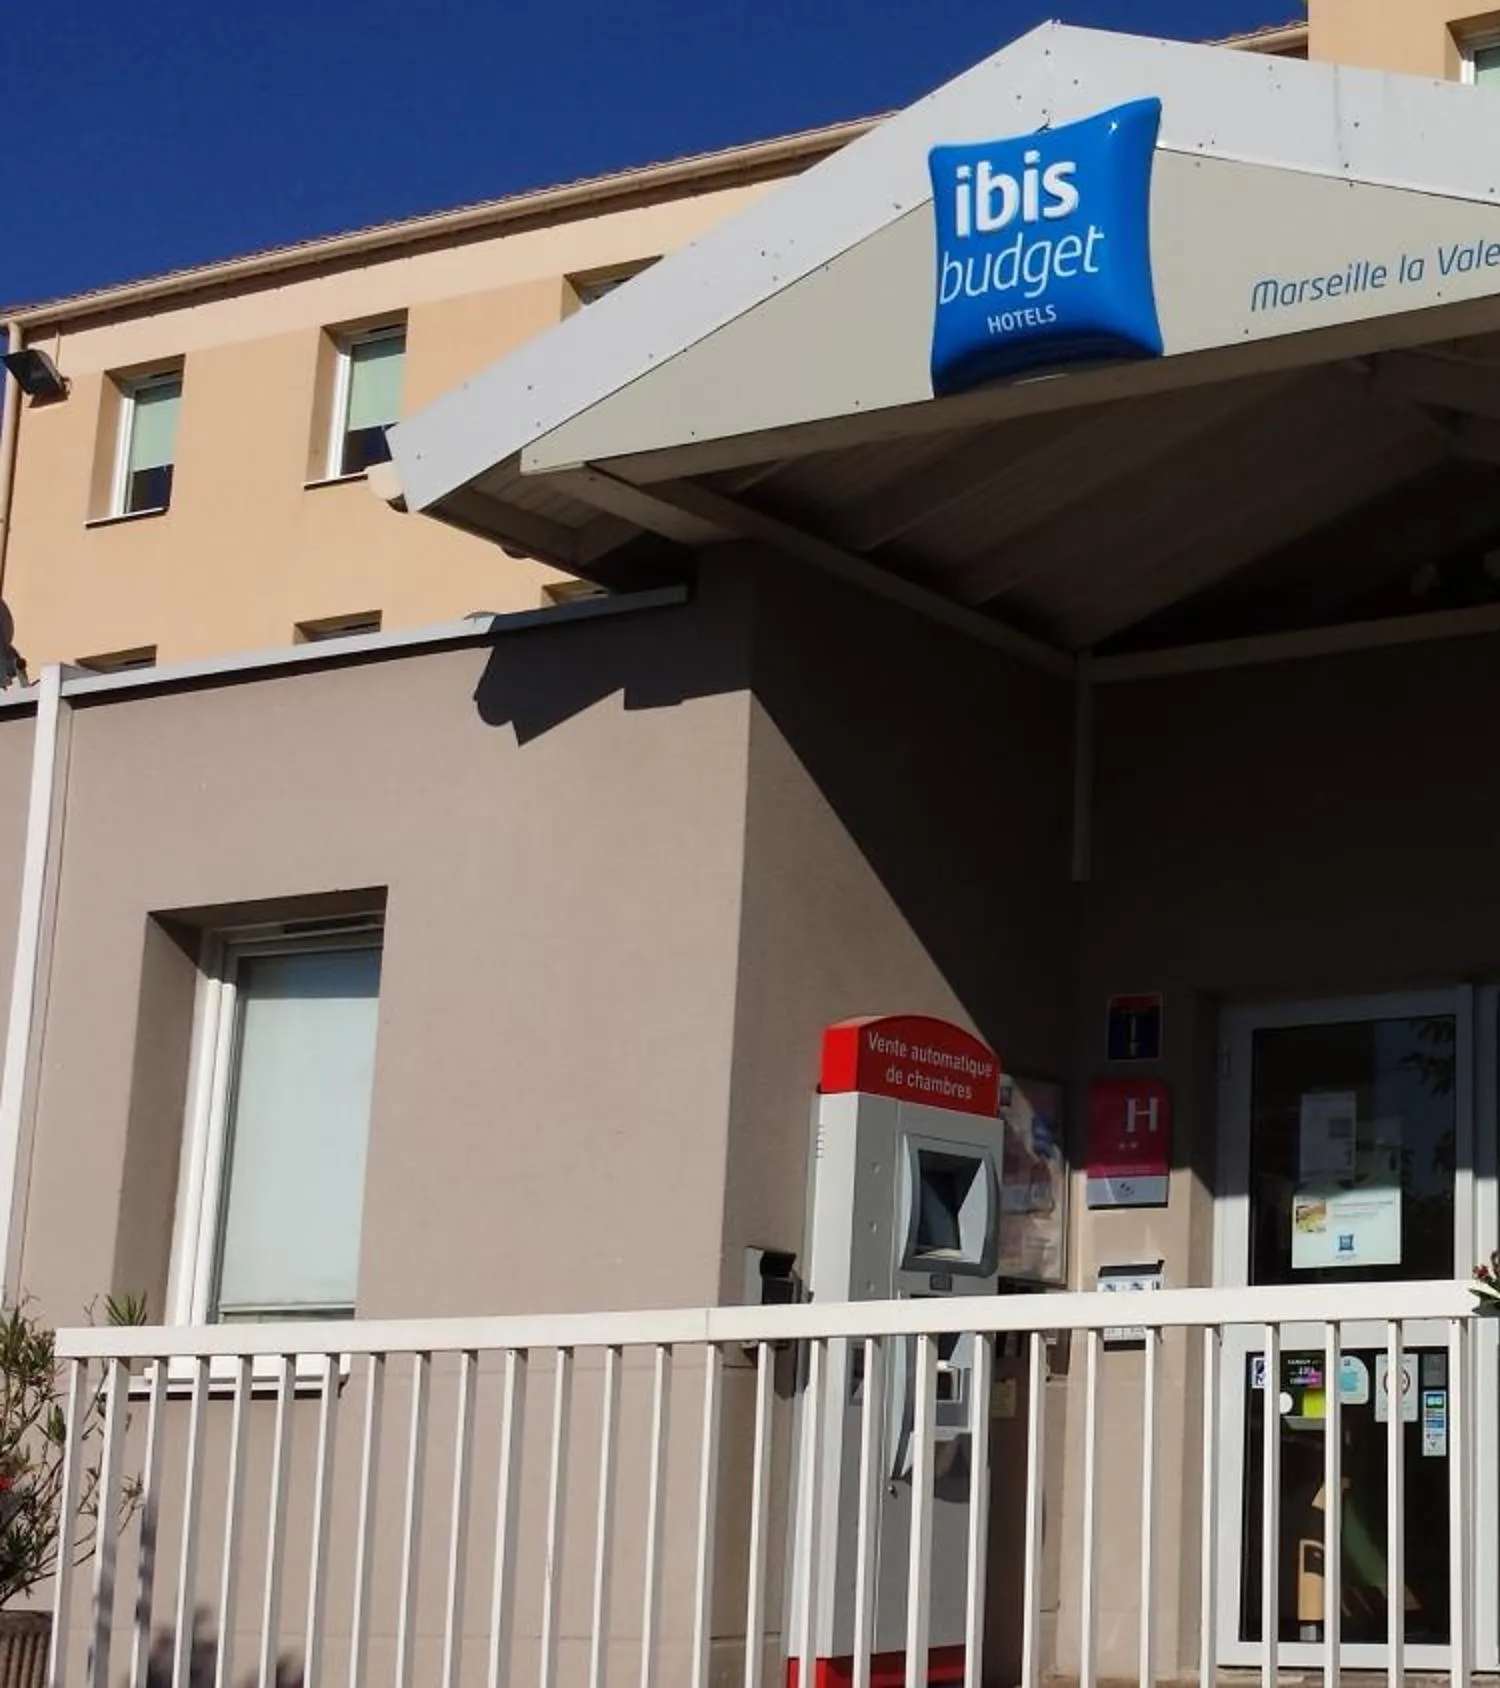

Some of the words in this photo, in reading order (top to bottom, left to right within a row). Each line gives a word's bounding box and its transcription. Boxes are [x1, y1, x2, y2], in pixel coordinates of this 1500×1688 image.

[956, 150, 1080, 238] ibis
[940, 225, 1105, 304] budget
[1251, 261, 1388, 312] Marseille
[1399, 254, 1425, 284] la
[987, 304, 1057, 333] HOTELS
[868, 1031, 908, 1057] Vente
[911, 1045, 992, 1078] automatique
[885, 1065, 903, 1085] de
[907, 1071, 973, 1099] chambres
[1126, 1097, 1158, 1133] H
